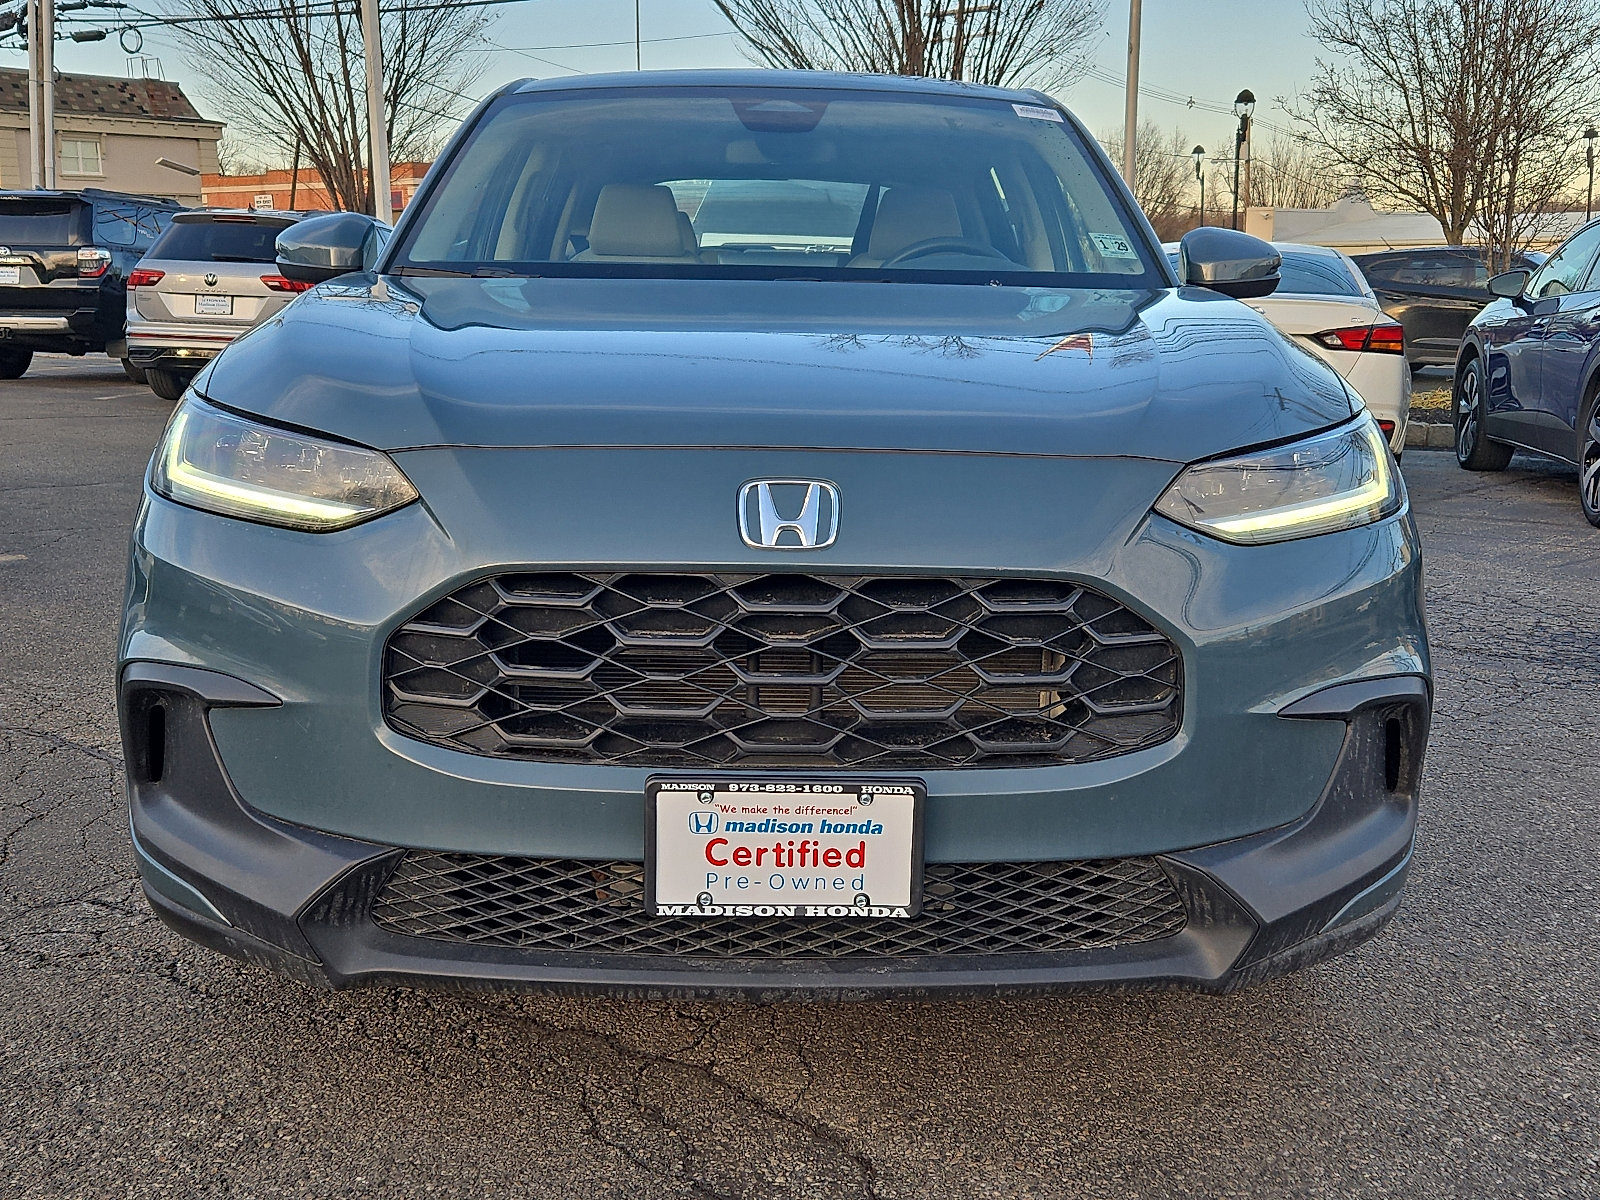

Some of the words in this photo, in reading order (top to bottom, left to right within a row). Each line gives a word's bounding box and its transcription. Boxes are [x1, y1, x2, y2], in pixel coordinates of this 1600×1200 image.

[1099, 239, 1109, 249] 1
[1114, 241, 1129, 251] 29
[661, 783, 715, 791] MADISON
[728, 783, 844, 793] 973-822-1600
[860, 785, 915, 795] HONDA
[741, 805, 768, 815] make
[773, 805, 790, 815] the
[724, 818, 813, 835] madison
[819, 818, 884, 835] honda
[704, 837, 867, 868] Certified
[705, 872, 865, 891] Pre-Owned
[656, 905, 795, 917] MADISON
[805, 905, 911, 918] HONDA
